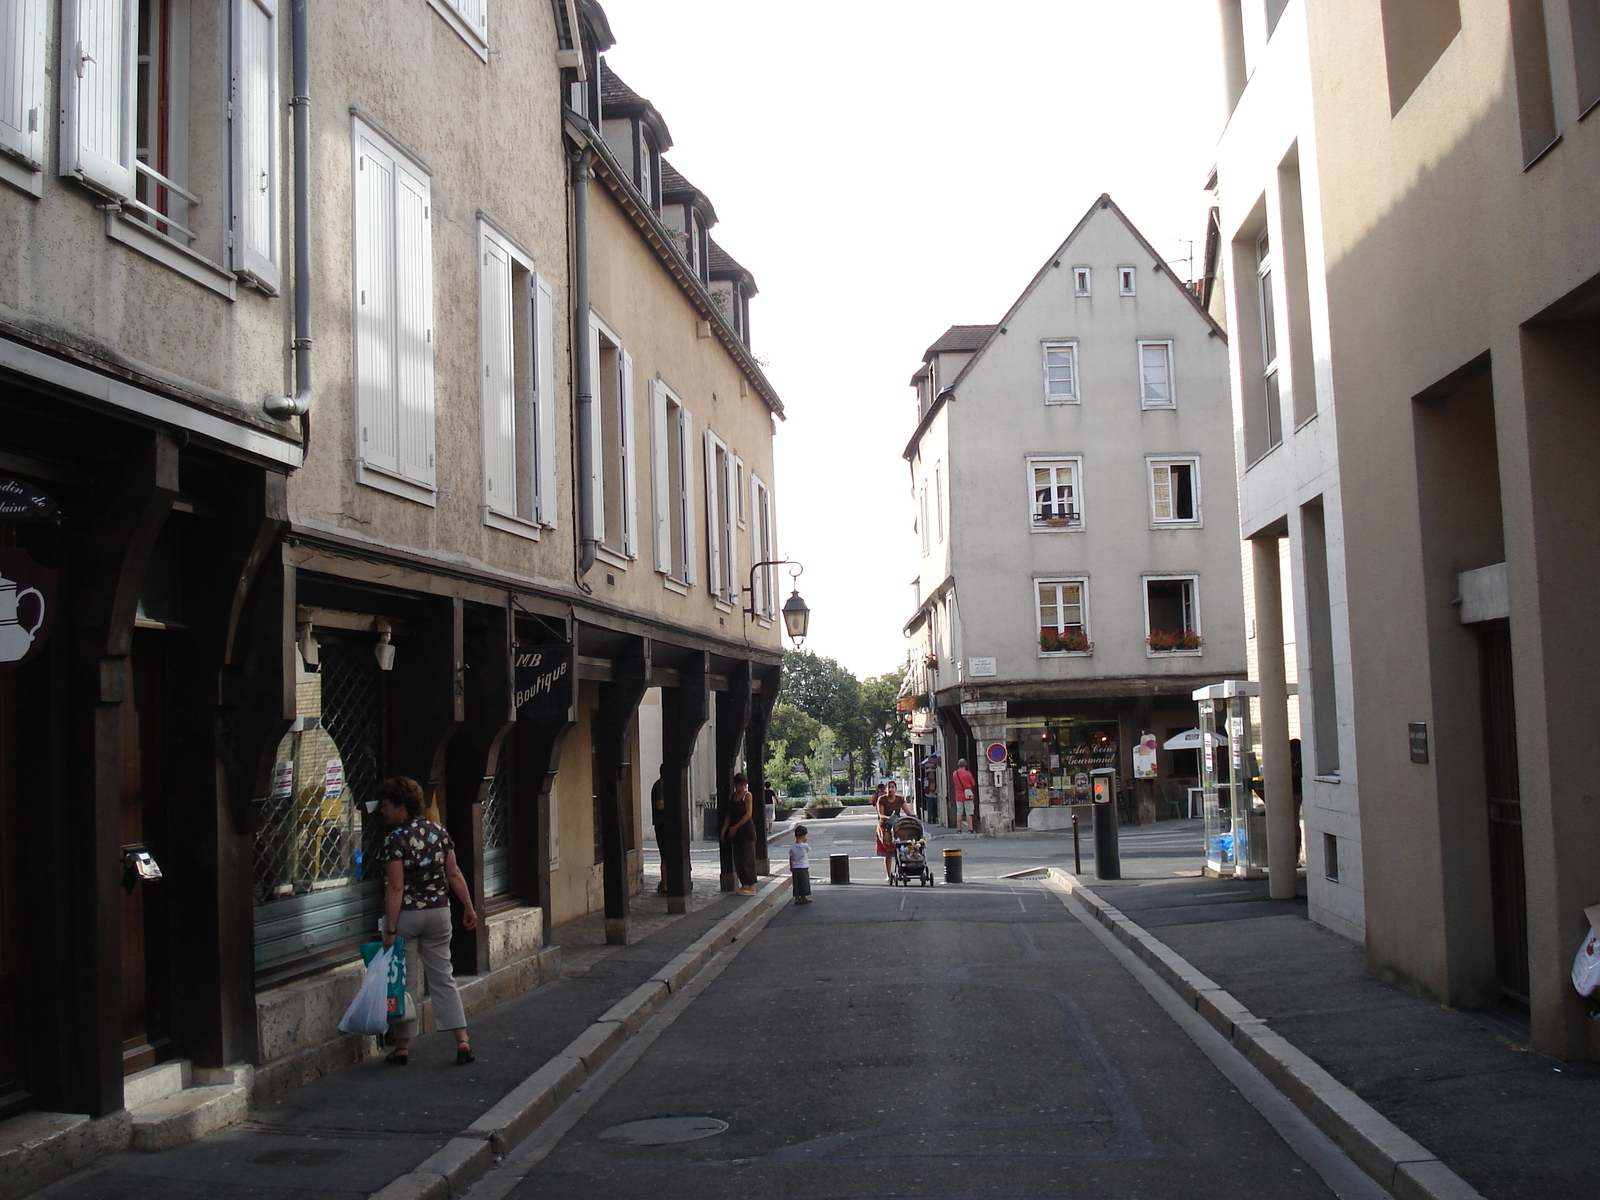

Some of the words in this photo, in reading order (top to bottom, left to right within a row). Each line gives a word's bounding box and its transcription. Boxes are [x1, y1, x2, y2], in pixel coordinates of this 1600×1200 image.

[31, 496, 46, 508] de
[515, 653, 543, 668] MB
[516, 661, 568, 709] Boutique
[1069, 744, 1085, 755] Au
[1091, 743, 1113, 754] Coin
[1066, 753, 1116, 765] Gourmand
